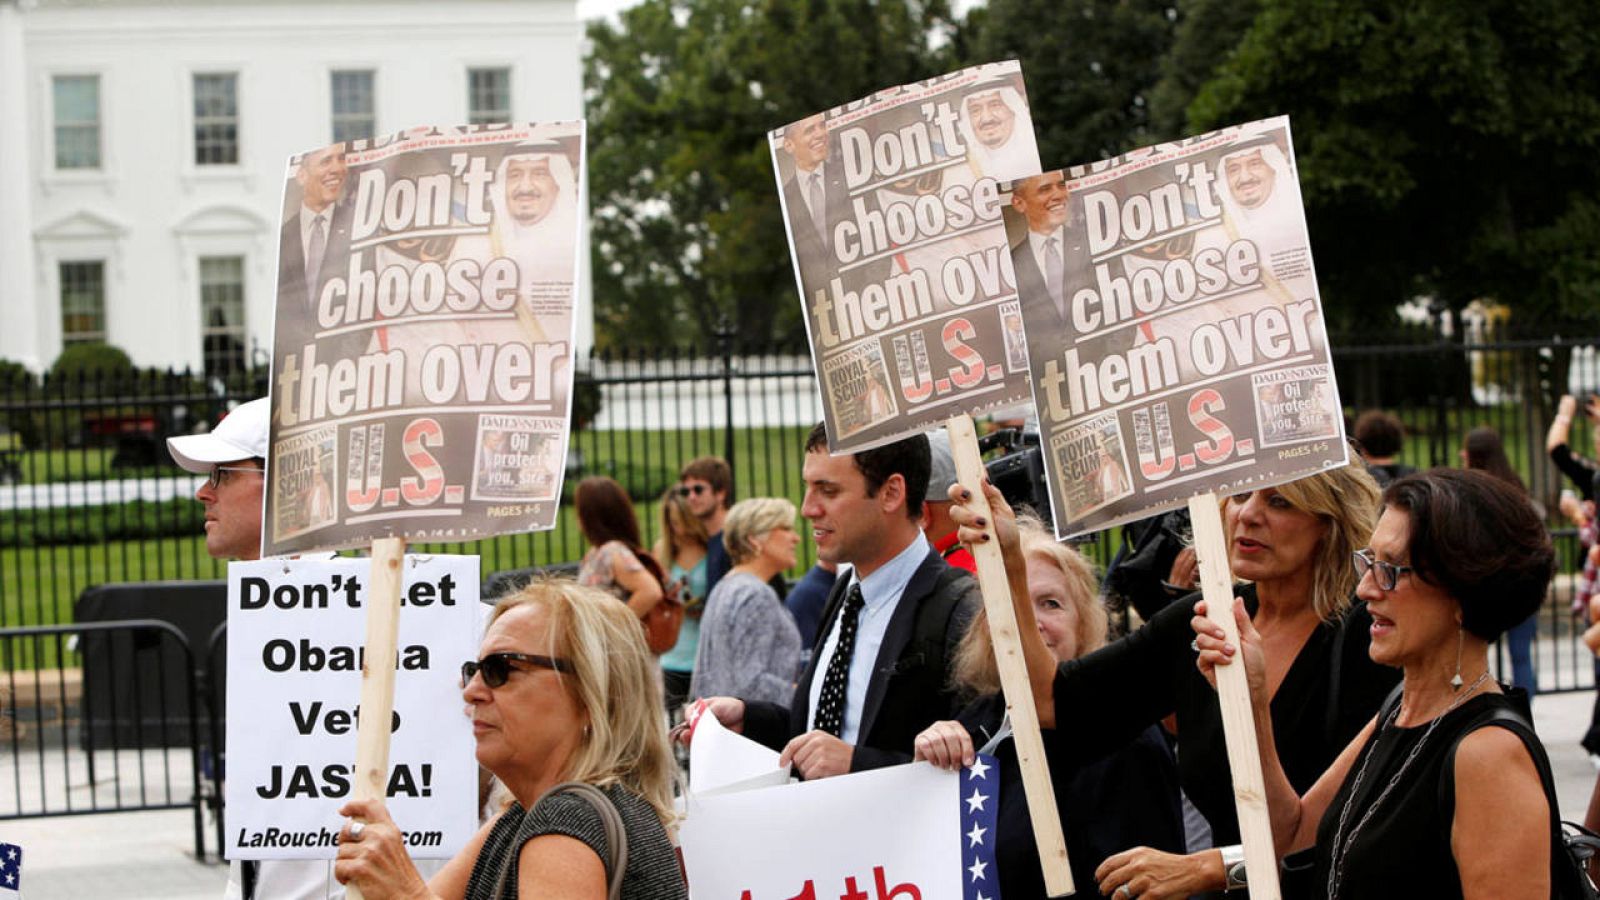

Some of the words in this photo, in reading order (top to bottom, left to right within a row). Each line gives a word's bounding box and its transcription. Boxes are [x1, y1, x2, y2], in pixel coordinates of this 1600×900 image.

[840, 101, 967, 189] Don't
[350, 152, 494, 241] Don't
[1083, 162, 1222, 256] Don't
[833, 176, 1001, 264] choose
[317, 252, 520, 329] choose
[813, 268, 936, 349] them
[941, 244, 1018, 306] ov
[1071, 239, 1261, 334] choose
[830, 360, 867, 389] ROYAL
[892, 318, 1005, 404] U.S.
[1040, 336, 1180, 424] them
[1190, 299, 1317, 376] over
[1255, 372, 1287, 385] DAILY
[1292, 365, 1329, 378] NEWS
[278, 344, 406, 427] them
[420, 342, 567, 404] over
[834, 376, 868, 402] SCUM
[1284, 382, 1301, 398] Oil
[481, 417, 517, 428] DAILY
[523, 419, 563, 430] NEWS
[1132, 388, 1255, 481] U.S.
[278, 446, 317, 475] ROYAL
[510, 433, 530, 452] Oil
[1057, 433, 1101, 466] ROYAL
[1278, 446, 1311, 459] PAGES
[1312, 441, 1329, 452] 4-5
[345, 418, 465, 512] U.S.
[1061, 451, 1101, 481] SCUM
[279, 468, 315, 499] SCUM
[487, 506, 521, 518] PAGES
[524, 503, 541, 514] 4-5
[240, 574, 362, 610] Don't
[400, 574, 456, 606] et
[256, 764, 433, 800] JASA!
